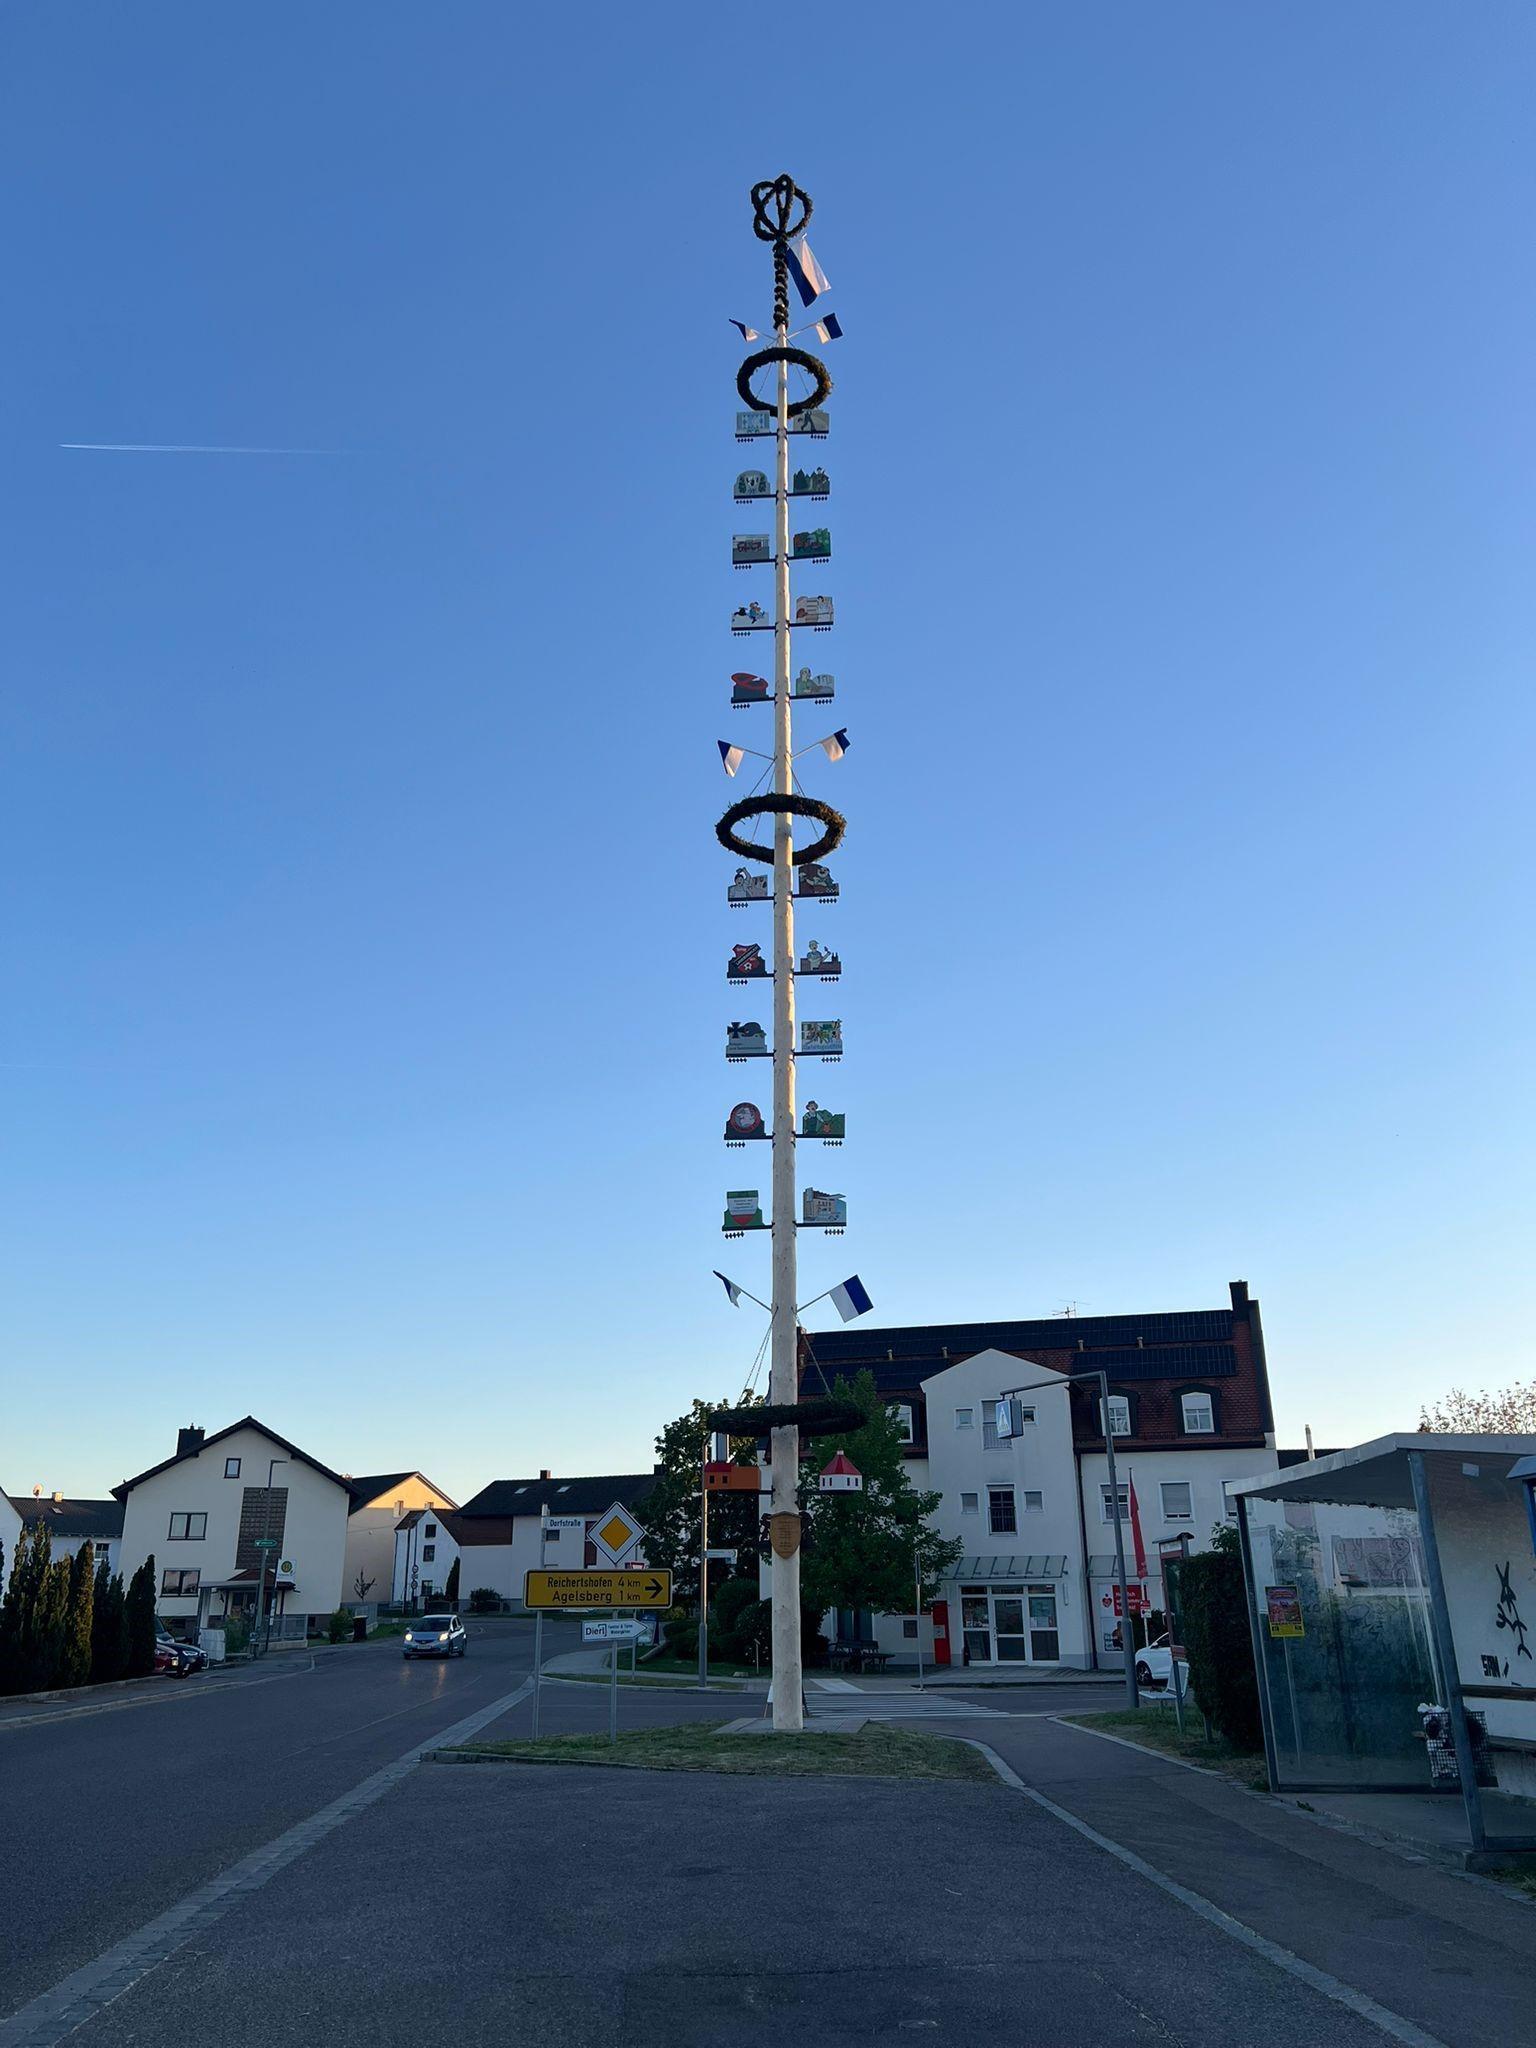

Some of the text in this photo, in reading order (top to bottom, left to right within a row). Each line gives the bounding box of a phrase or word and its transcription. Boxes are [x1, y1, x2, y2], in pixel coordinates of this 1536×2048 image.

[550, 1519, 581, 1527] Dorfstraße
[547, 1576, 641, 1588] Reichertshofen 4 km
[552, 1590, 641, 1604] Agelsberg 1 km
